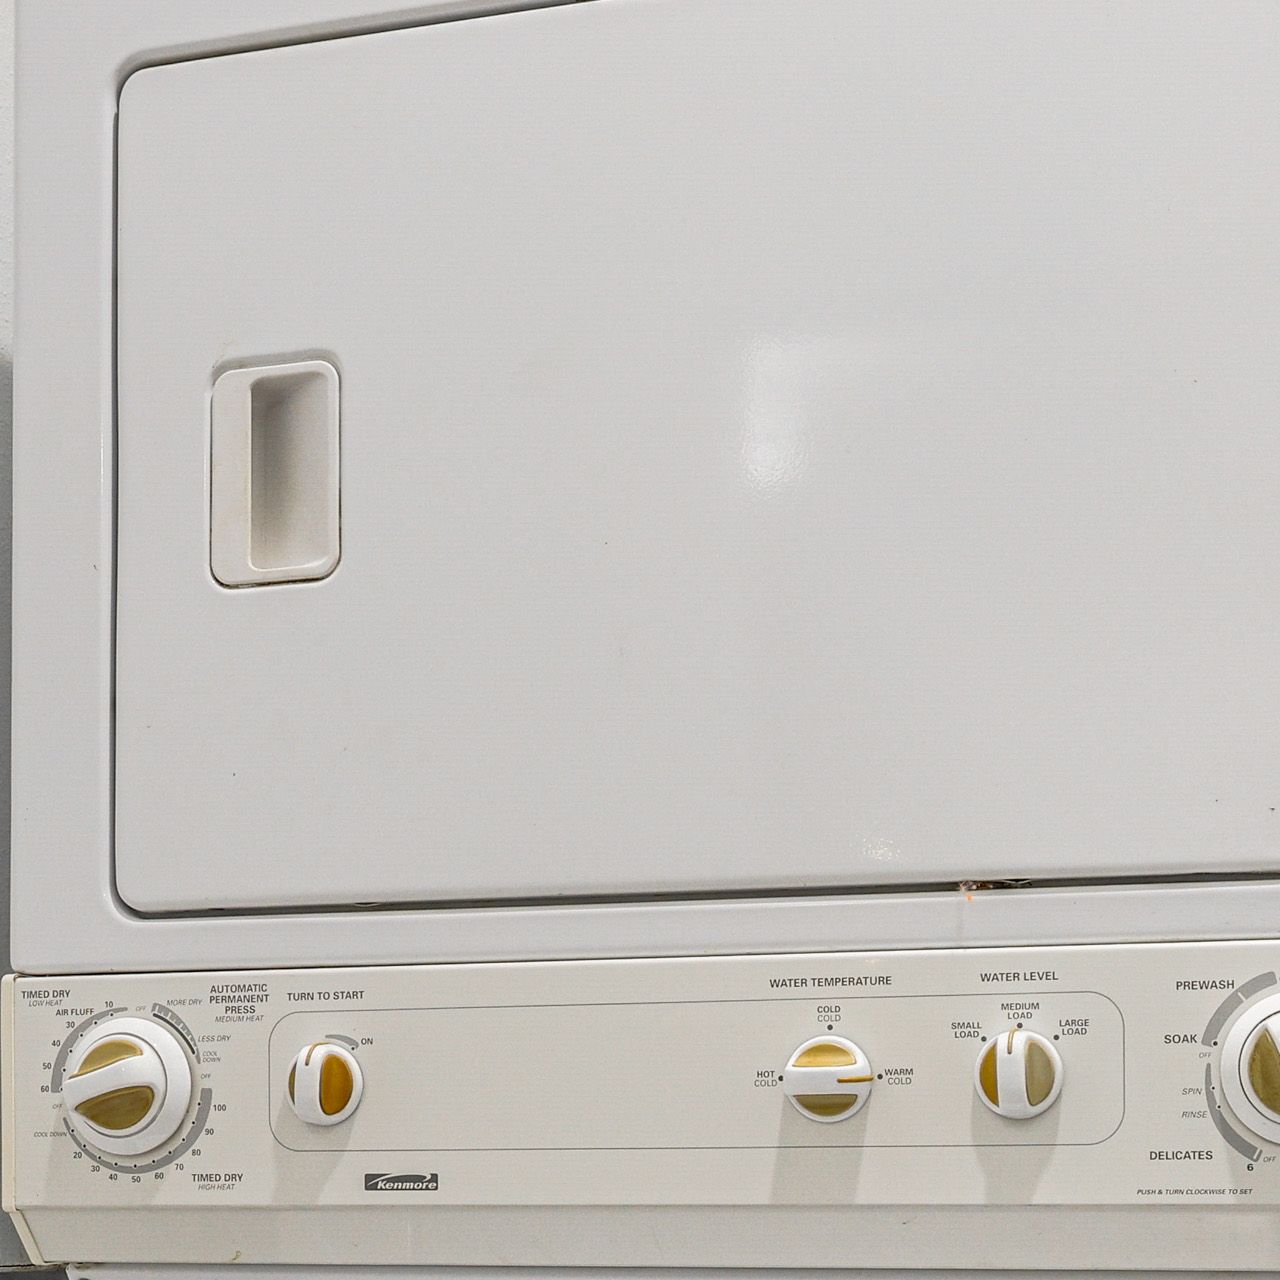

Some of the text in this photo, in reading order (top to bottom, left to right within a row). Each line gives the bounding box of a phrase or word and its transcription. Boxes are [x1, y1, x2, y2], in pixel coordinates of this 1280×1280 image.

[980, 971, 1059, 982] WATER LEVEL
[770, 976, 892, 988] WATER TEMPERATURE
[1176, 980, 1235, 990] PREWASH
[210, 984, 267, 993] AUTOMATIC
[21, 990, 70, 999] TIMED DRY
[210, 994, 269, 1004] PERMANENT
[287, 991, 365, 1001] TURN TO START
[225, 1005, 255, 1014] PRESS
[817, 1005, 841, 1014] COLD
[1001, 1002, 1040, 1011] MEDIUM
[70, 1008, 94, 1016] FLUFF
[1007, 1011, 1033, 1019] LOAD
[817, 1014, 841, 1022] COLD
[1059, 1018, 1090, 1027] LARGE
[951, 1022, 982, 1030] SMALL
[954, 1030, 980, 1038] LOAD
[1062, 1027, 1087, 1036] LOAD
[1164, 1034, 1197, 1044] SOAK
[756, 1071, 775, 1079] HOT
[884, 1068, 914, 1077] WARM
[754, 1079, 777, 1087] COLD
[887, 1077, 911, 1085] COLD
[1149, 1151, 1213, 1161] DELICATES
[1247, 1164, 1254, 1172] 6
[109, 1173, 118, 1181] 40
[192, 1173, 243, 1182] TIMED DRY
[377, 1180, 437, 1190] Kenmore
